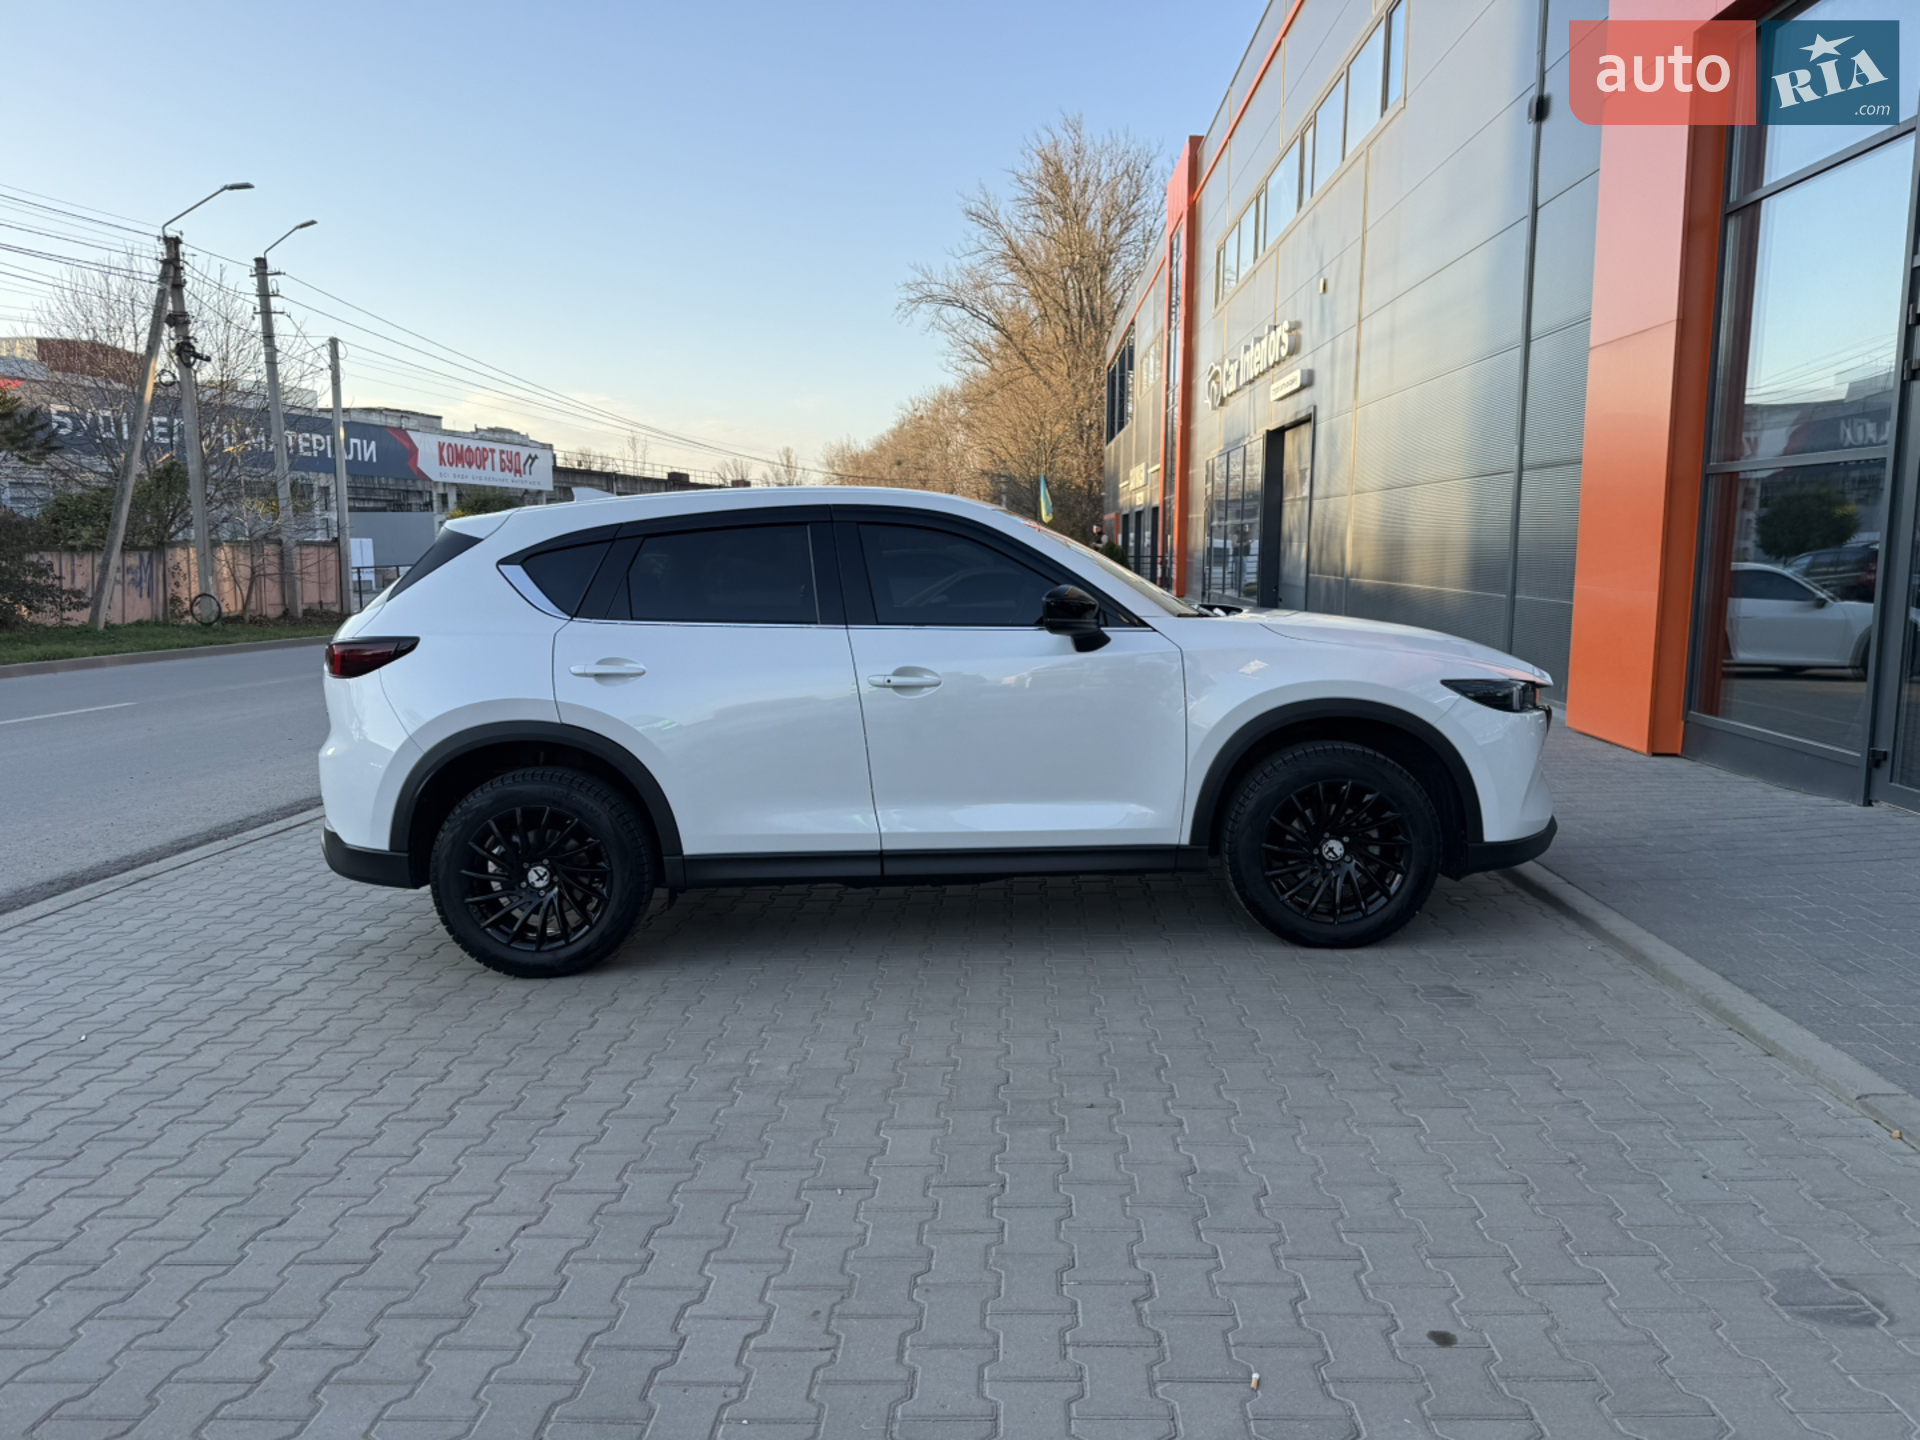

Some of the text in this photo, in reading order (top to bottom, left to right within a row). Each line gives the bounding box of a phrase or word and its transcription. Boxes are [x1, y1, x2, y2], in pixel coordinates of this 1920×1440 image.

[1223, 358, 1240, 398] Car
[1240, 320, 1290, 386] Interiors
[244, 427, 377, 463] МТЕРІЛИ
[437, 441, 523, 478] КОМФОРТ БУД
[552, 788, 602, 820] YOKOHAMA
